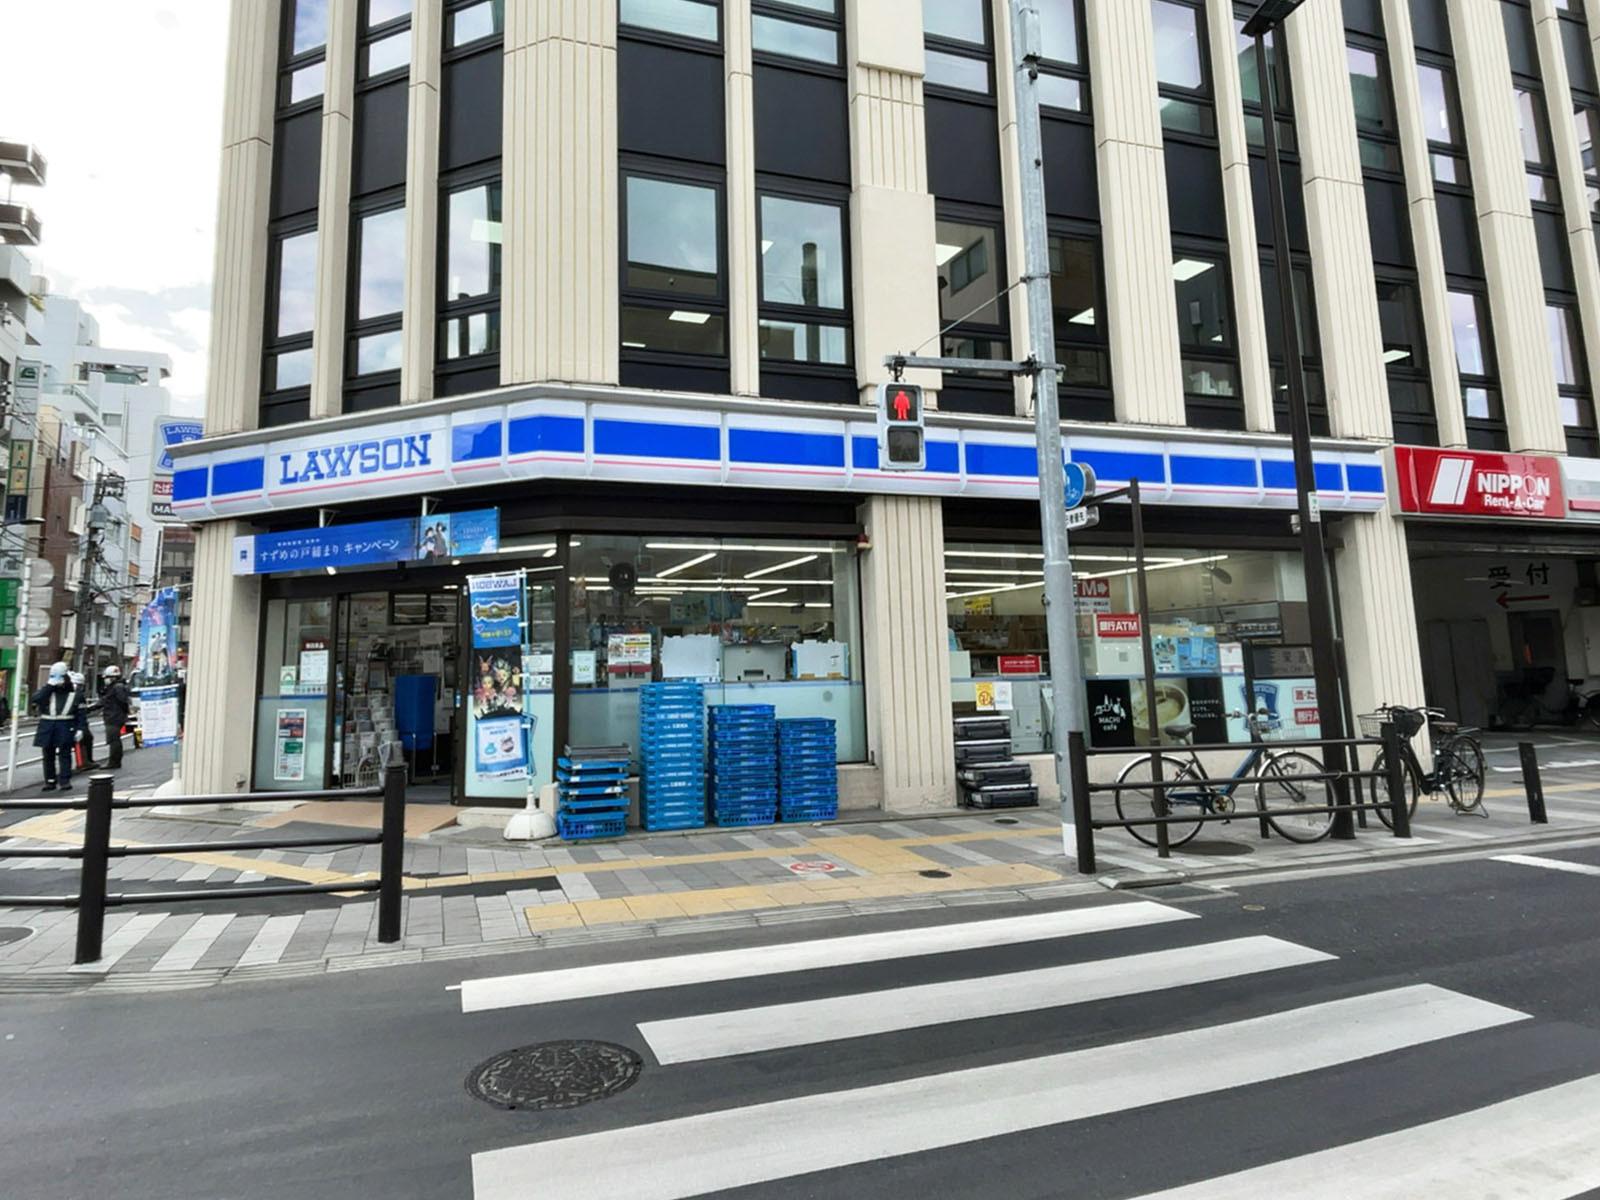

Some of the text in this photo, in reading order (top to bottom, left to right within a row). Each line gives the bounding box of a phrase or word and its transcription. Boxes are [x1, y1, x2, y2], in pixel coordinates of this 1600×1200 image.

[279, 434, 431, 485] LAWSON
[1477, 473, 1549, 496] NIPPON
[1484, 494, 1546, 510] Rent-A-Car
[344, 539, 399, 554] キャンペーン
[1488, 562, 1549, 589] 受付
[1099, 621, 1138, 631] 銀行ATM
[1098, 716, 1121, 724] MACHI
